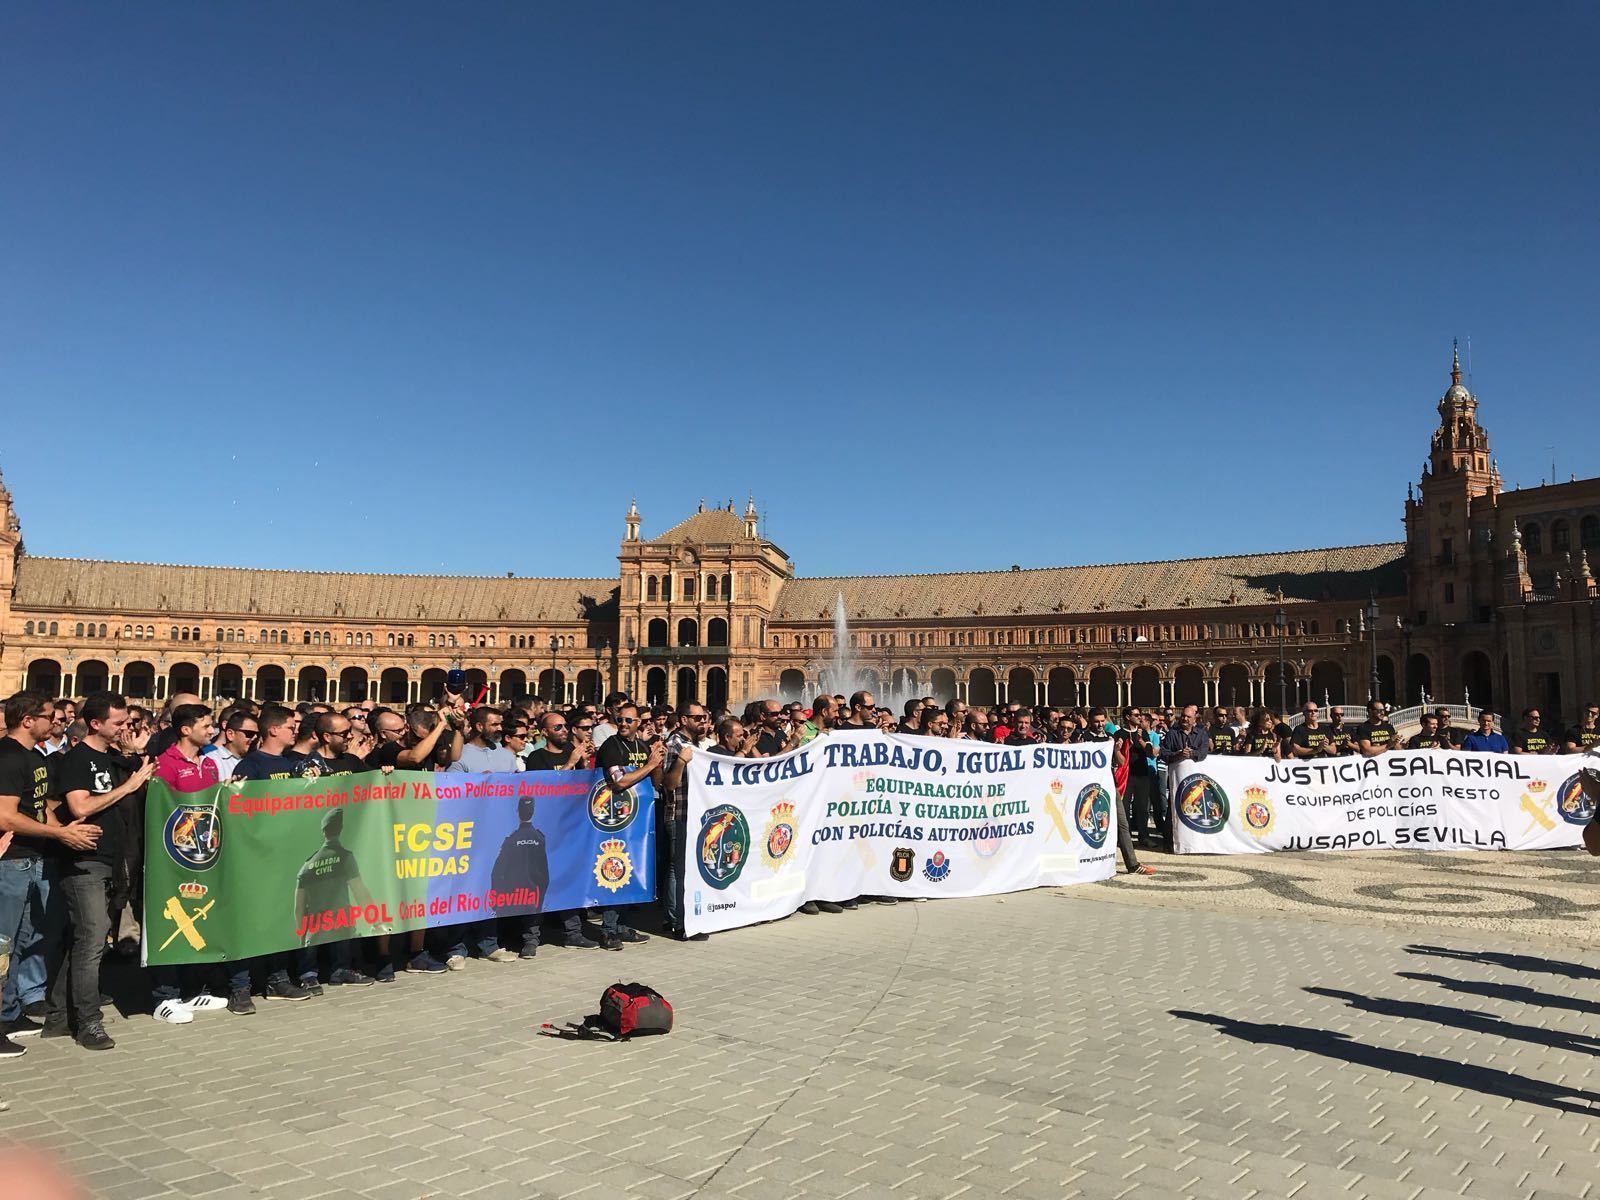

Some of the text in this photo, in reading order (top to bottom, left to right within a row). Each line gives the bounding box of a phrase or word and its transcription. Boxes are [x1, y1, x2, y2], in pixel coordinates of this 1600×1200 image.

[705, 741, 1107, 786] A IGUAL TRABAJO, IGUAL SUELDO
[1264, 755, 1531, 785] JUSTICIA SALARIAL
[228, 788, 349, 818] Equiparación
[351, 781, 407, 803] Salarial
[412, 782, 432, 800] YA
[435, 786, 461, 800] con
[866, 777, 1006, 799] EQUIPARACIÓN DE
[1285, 784, 1500, 806] EQUIPARACIÓN CON RESTO
[826, 794, 1030, 820] POLICÍA Y GUARDIA CIVIL
[1347, 802, 1438, 823] DE POLICÍAS
[393, 820, 475, 853] FCSE
[811, 825, 844, 846] CON
[848, 820, 924, 841] POLICÍAS
[928, 820, 1035, 842] AUTONÓMICAS
[1282, 826, 1507, 850] JUSAPOL SEVILLA
[308, 856, 341, 870] GUARDIA
[315, 865, 333, 876] CIVIL
[395, 855, 470, 879] UNIDAS
[296, 885, 540, 937] JUSAPOL Coria del Río (Sevilla)
